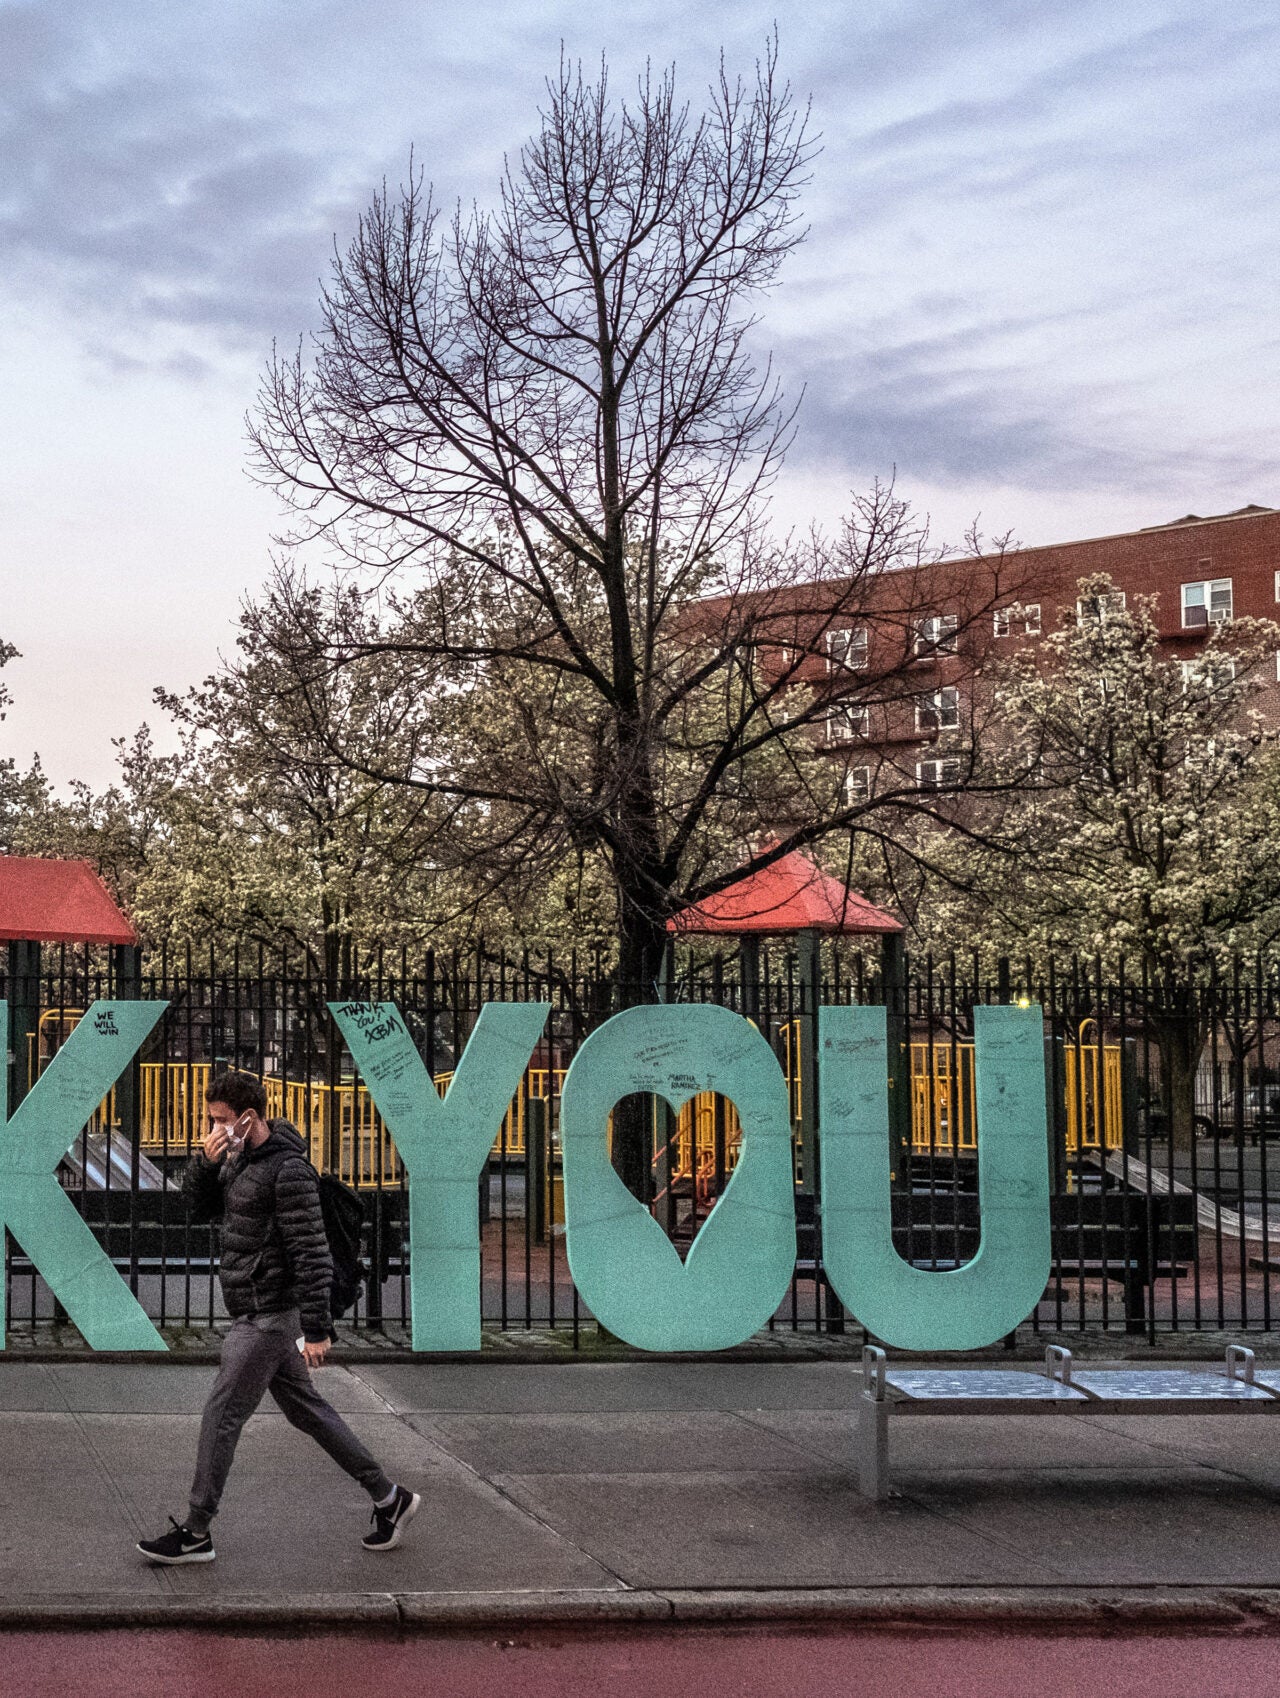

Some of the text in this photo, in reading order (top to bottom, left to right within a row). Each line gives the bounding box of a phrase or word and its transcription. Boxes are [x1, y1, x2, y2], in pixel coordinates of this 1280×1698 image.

[336, 1001, 385, 1017] THANK
[97, 1011, 115, 1021] WE
[94, 1020, 117, 1029] WILL
[98, 1028, 119, 1036] WIN
[326, 1001, 1052, 1353] YOU
